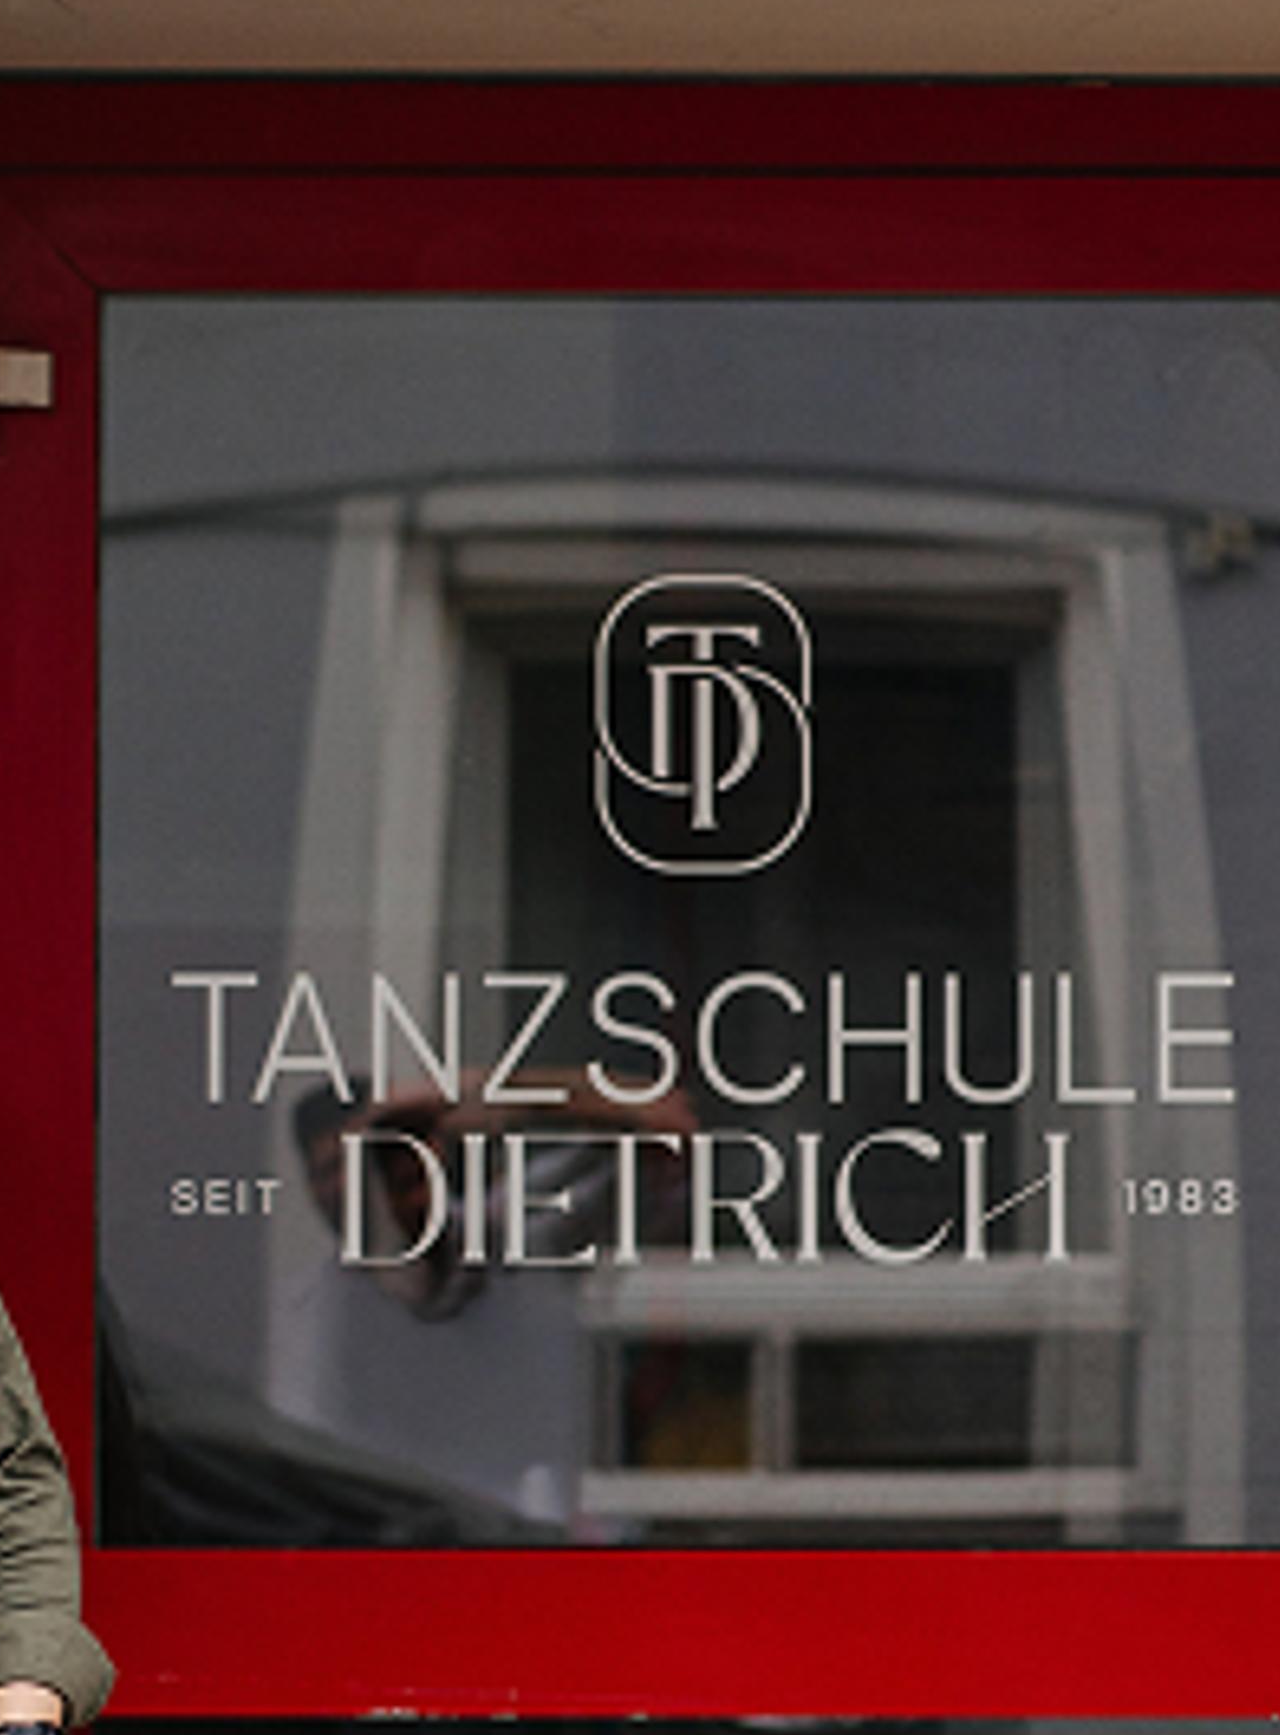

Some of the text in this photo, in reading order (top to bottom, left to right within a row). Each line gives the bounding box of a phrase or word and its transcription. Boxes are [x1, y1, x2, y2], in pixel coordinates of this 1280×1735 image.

[171, 971, 1237, 1106] TANZSCHULE
[169, 1131, 1238, 1268] SEIT DIETRICH 1983
